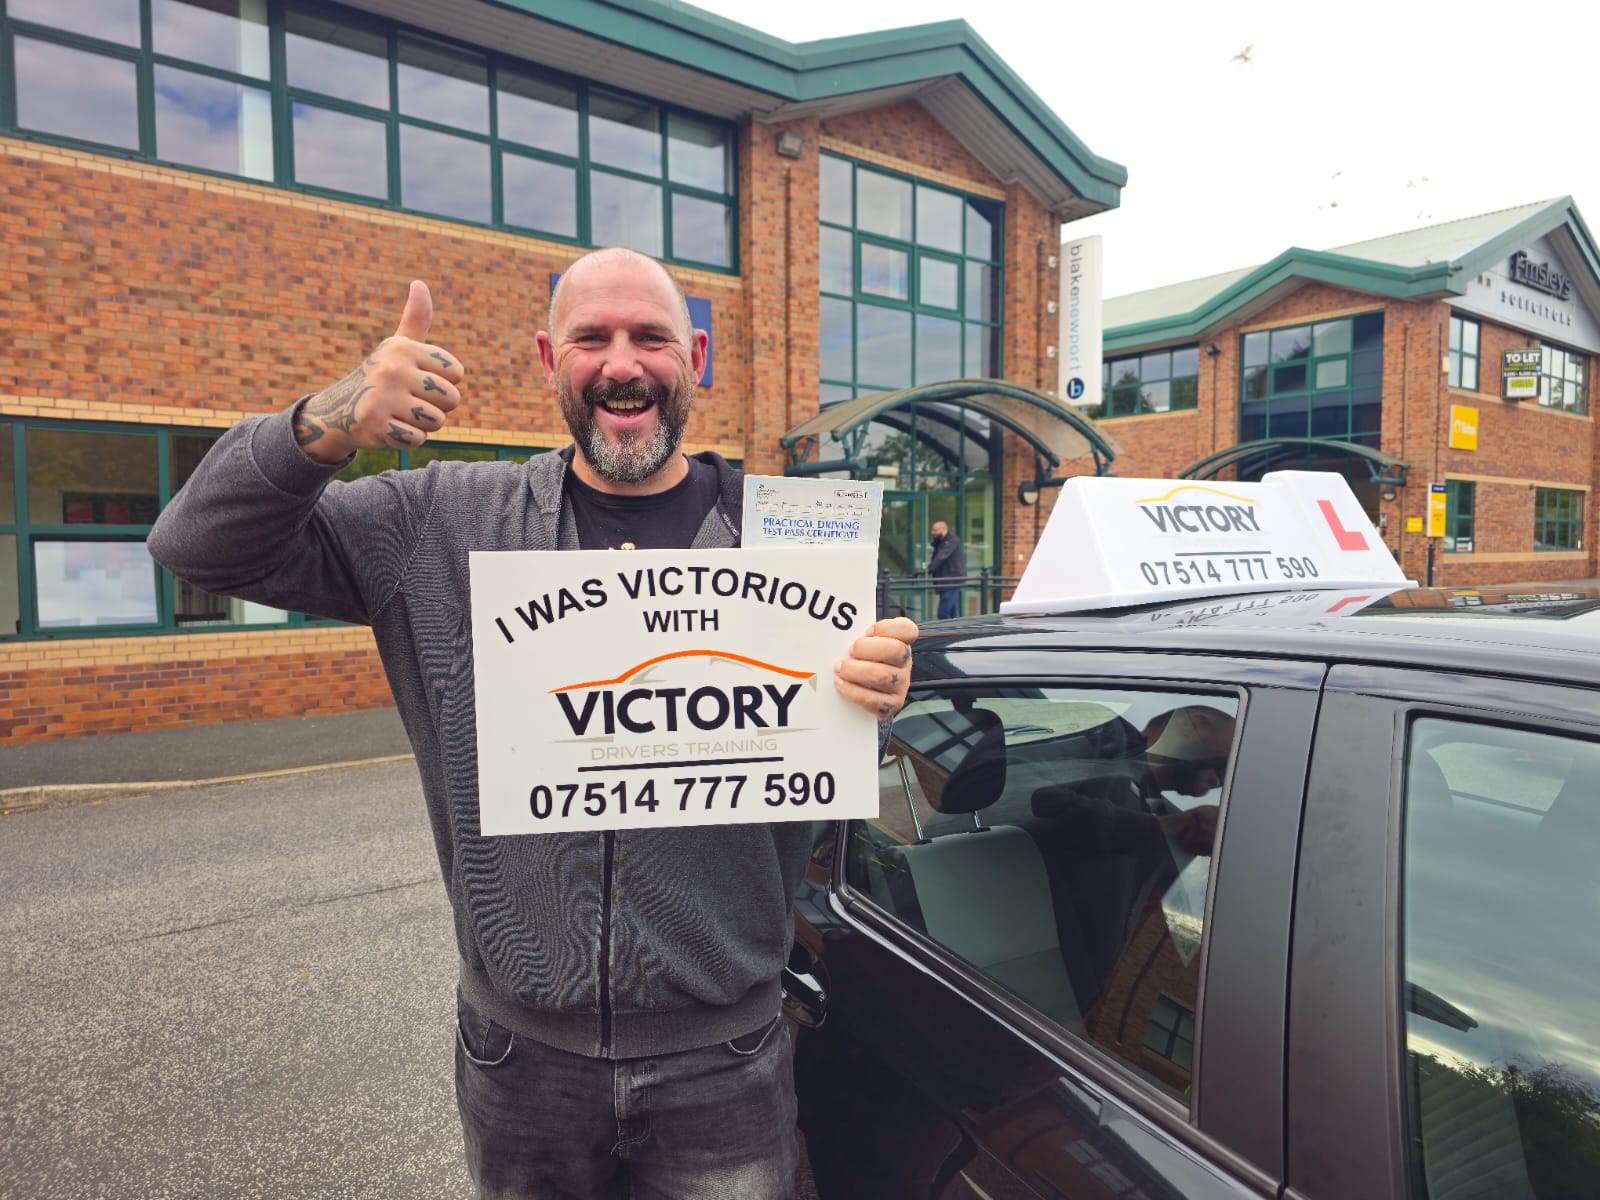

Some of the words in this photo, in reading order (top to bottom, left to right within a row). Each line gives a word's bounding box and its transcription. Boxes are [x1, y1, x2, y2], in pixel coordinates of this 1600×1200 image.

[1068, 244, 1083, 372] blakenewport
[1506, 353, 1521, 363] TO
[1522, 352, 1541, 363] LET
[763, 517, 814, 529] PRACTICAL
[817, 519, 860, 531] DRIVING
[1140, 505, 1260, 532] VICTORY
[1316, 500, 1370, 551] L
[762, 527, 783, 536] TEST
[784, 528, 805, 537] PASS
[806, 529, 859, 539] CERTIFICATE
[1140, 560, 1221, 586] 07514
[1224, 558, 1269, 581] 777
[1276, 556, 1319, 579] 590
[495, 616, 515, 644] I
[515, 579, 608, 633] WAS
[617, 566, 858, 631] VICTORIOUS
[643, 609, 719, 633] WITH
[556, 684, 803, 736] VICTORY
[591, 743, 679, 761] DRIVERS
[685, 738, 778, 756] TRAINING
[529, 780, 660, 820] 07514
[673, 775, 748, 811] 777
[763, 771, 836, 807] 590
